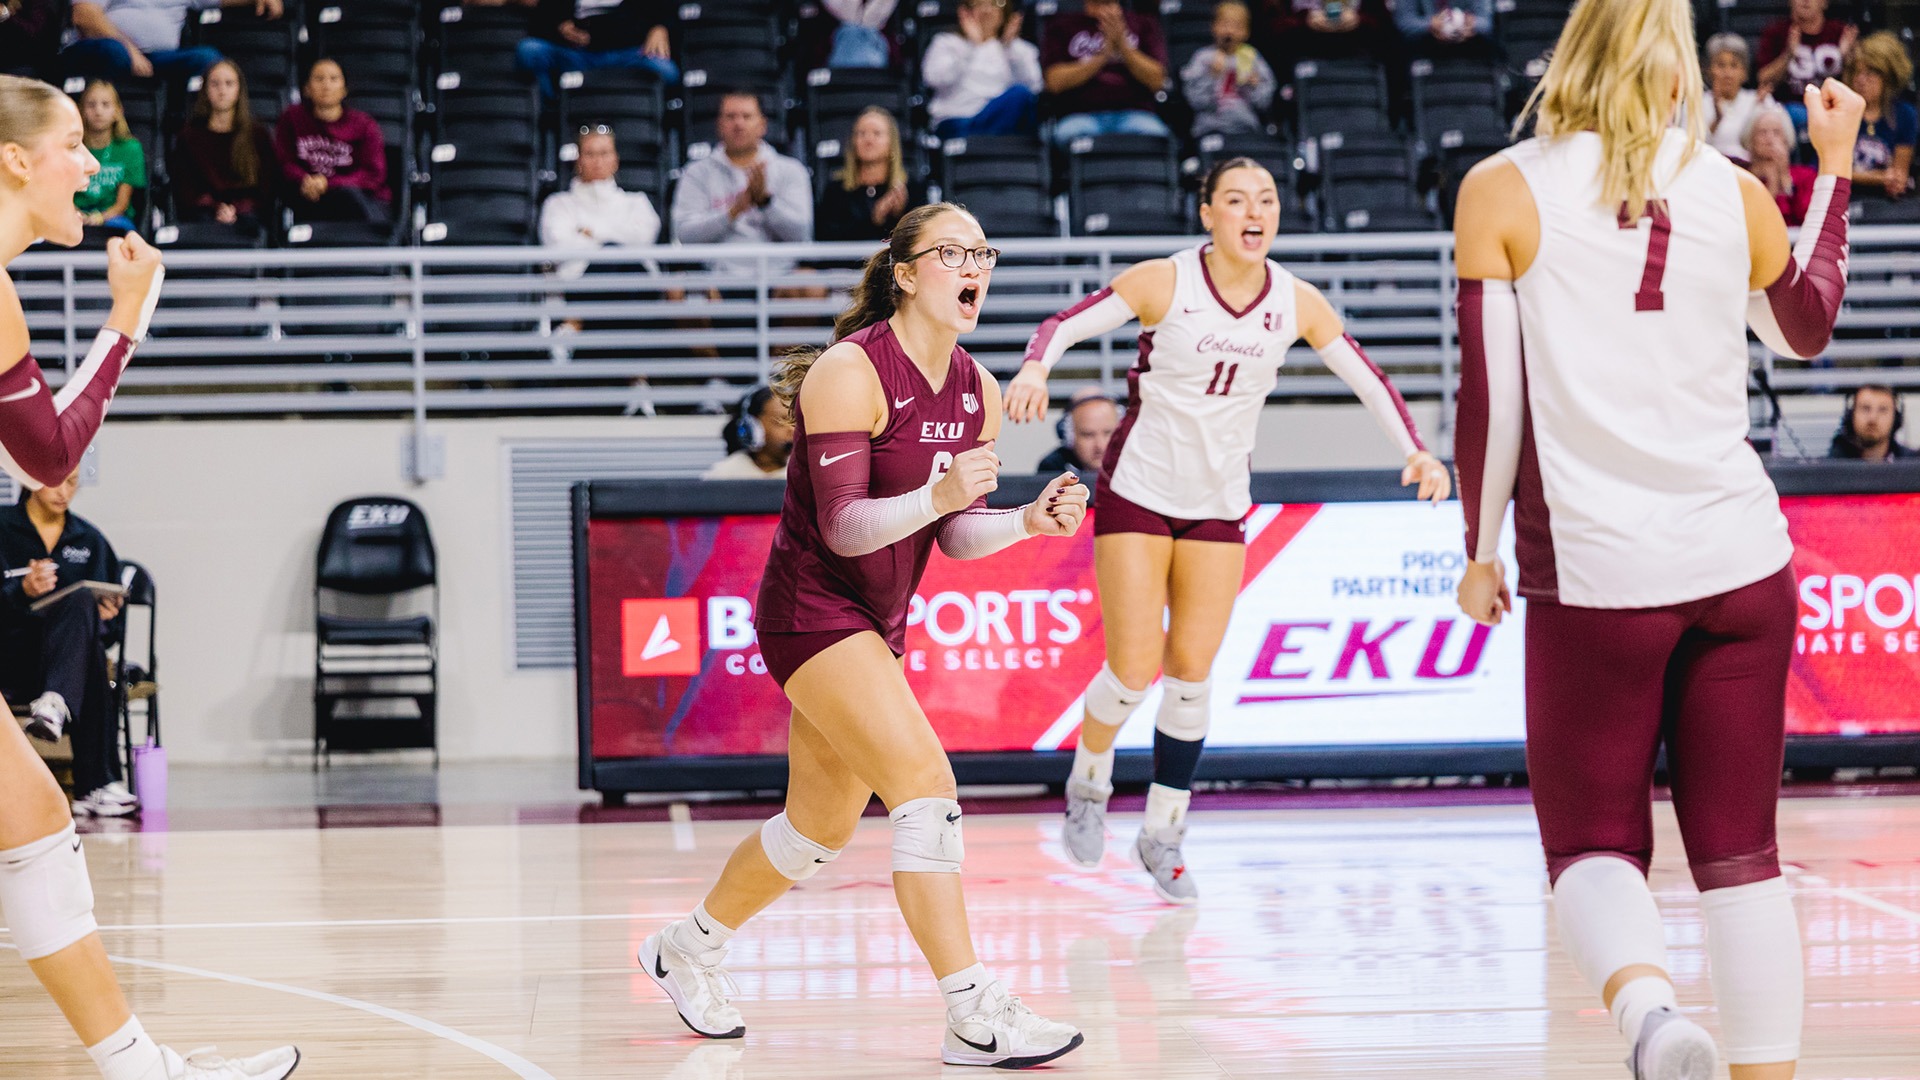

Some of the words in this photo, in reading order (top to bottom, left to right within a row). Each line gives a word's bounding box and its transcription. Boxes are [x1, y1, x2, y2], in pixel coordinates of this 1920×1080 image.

[1617, 199, 1671, 311] 7
[1196, 333, 1264, 357] Colonels
[1205, 361, 1238, 396] 11
[921, 421, 965, 439] EKU
[347, 505, 411, 527] EKU
[1332, 576, 1454, 596] PARTNER
[1799, 573, 1920, 630] SPO
[943, 647, 1062, 670] SELECT
[1246, 618, 1492, 680] EKU
